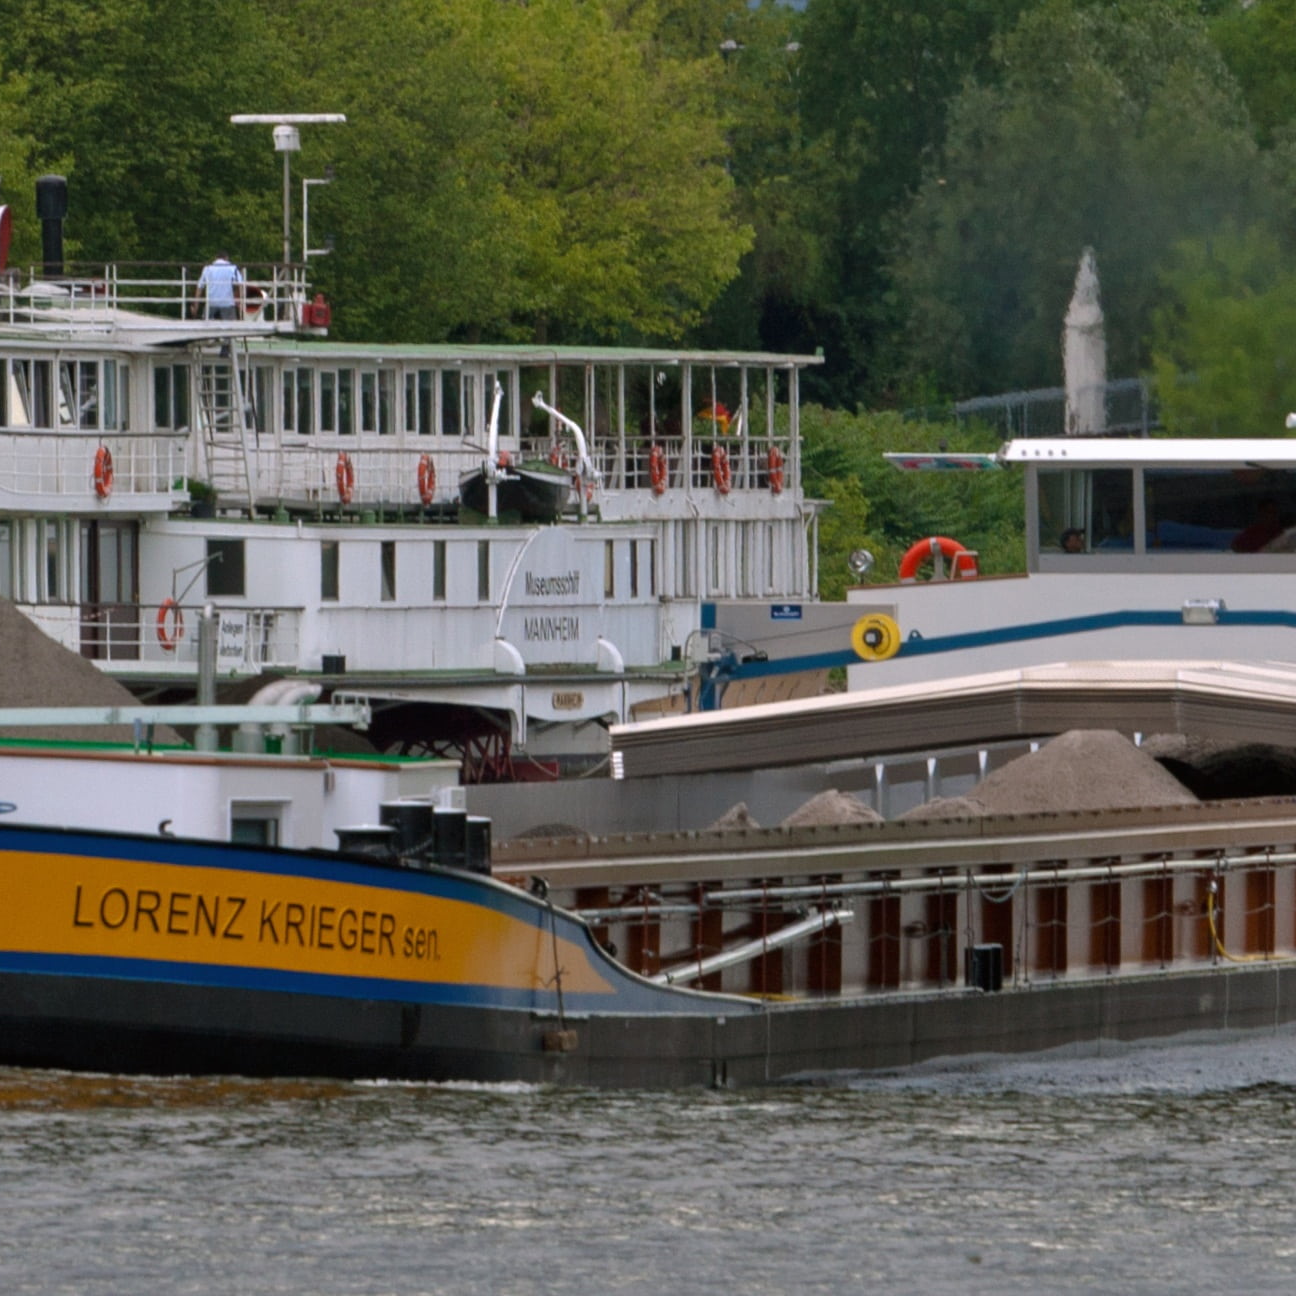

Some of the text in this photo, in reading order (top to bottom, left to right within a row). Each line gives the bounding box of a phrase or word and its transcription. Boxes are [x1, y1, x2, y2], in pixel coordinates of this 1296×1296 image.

[524, 570, 580, 596] Museumsschiff
[524, 616, 580, 641] MANNHEIM
[72, 885, 442, 961] LORENZ KRIEGER sen.
